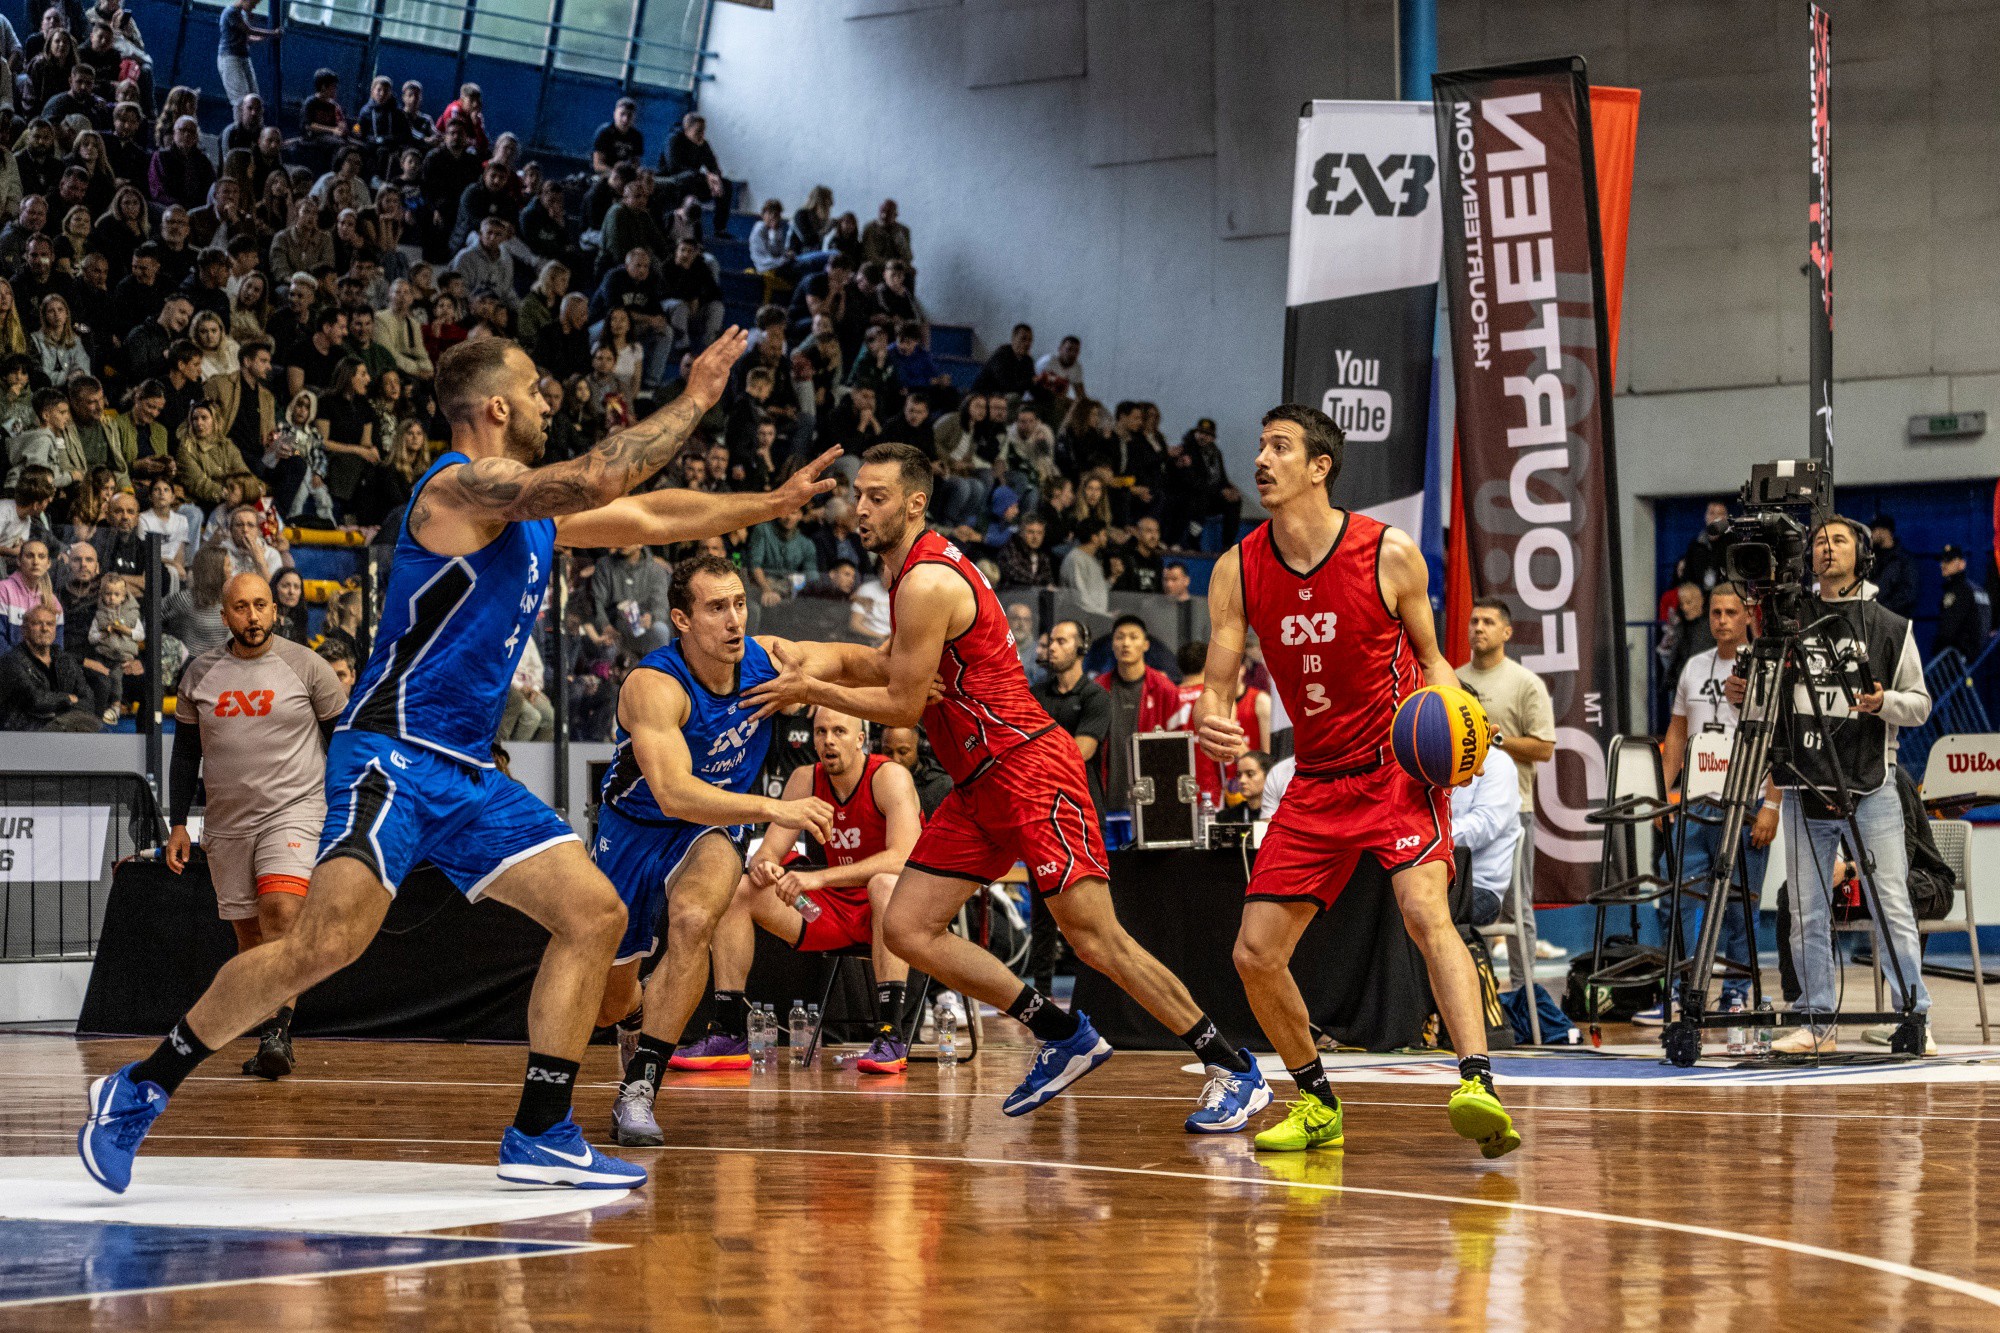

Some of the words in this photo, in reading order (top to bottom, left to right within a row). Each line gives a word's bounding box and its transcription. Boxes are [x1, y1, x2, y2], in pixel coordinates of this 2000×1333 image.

[1335, 350, 1380, 386] You
[1328, 397, 1386, 432] Tube
[1302, 654, 1323, 675] UB
[1304, 682, 1332, 717] 3
[1458, 705, 1478, 773] Wilson
[1698, 751, 1729, 774] Wilson
